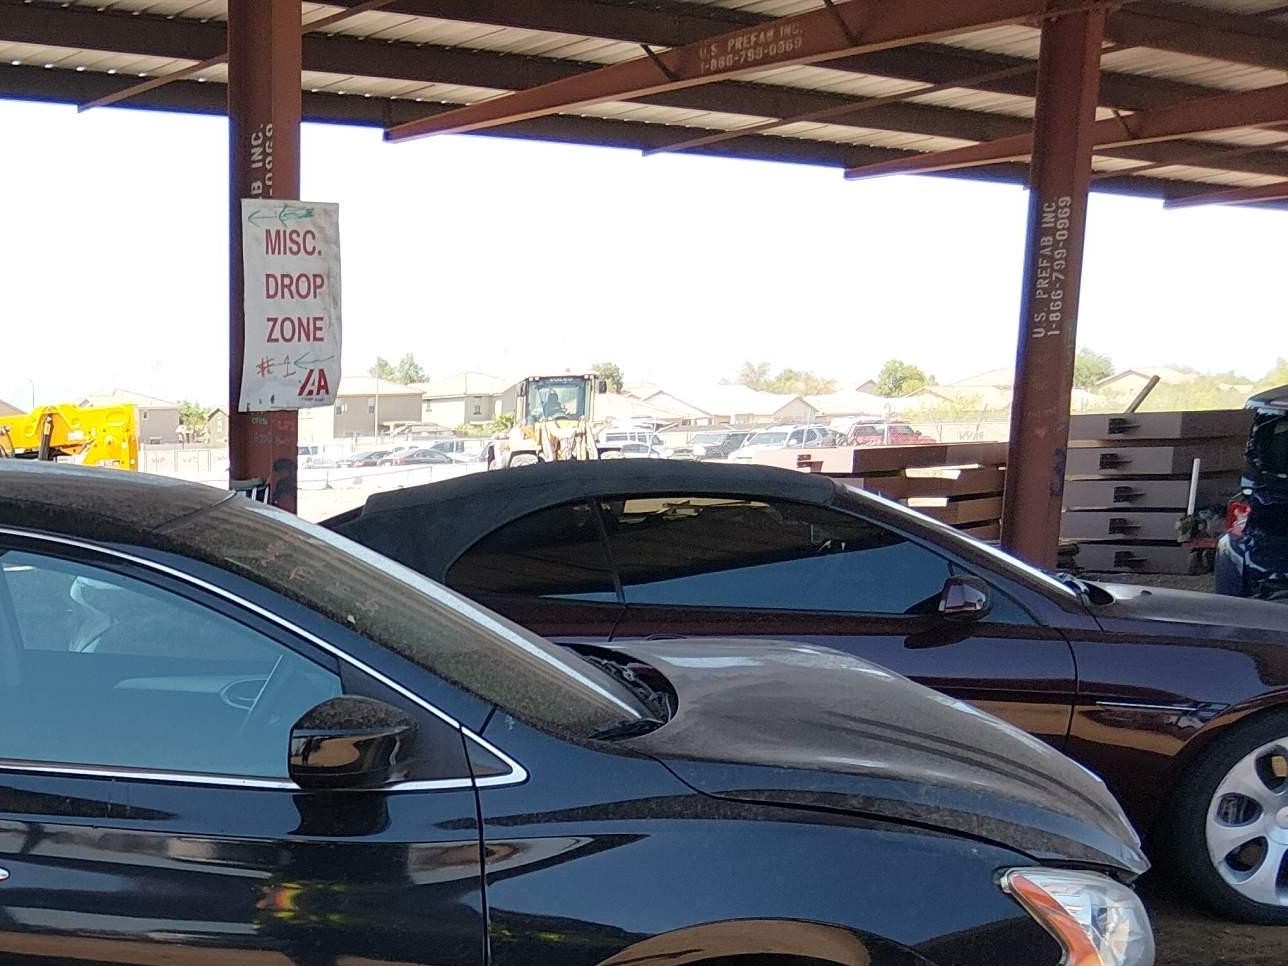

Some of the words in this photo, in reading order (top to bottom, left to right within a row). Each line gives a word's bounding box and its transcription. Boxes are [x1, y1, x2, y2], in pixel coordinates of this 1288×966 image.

[250, 123, 263, 168] INC.
[264, 228, 323, 257] MISC.
[1035, 236, 1054, 299] PREFAB
[1047, 196, 1072, 336] 1-866-799-0969
[264, 273, 325, 300] DROP
[265, 316, 325, 344] ZONE
